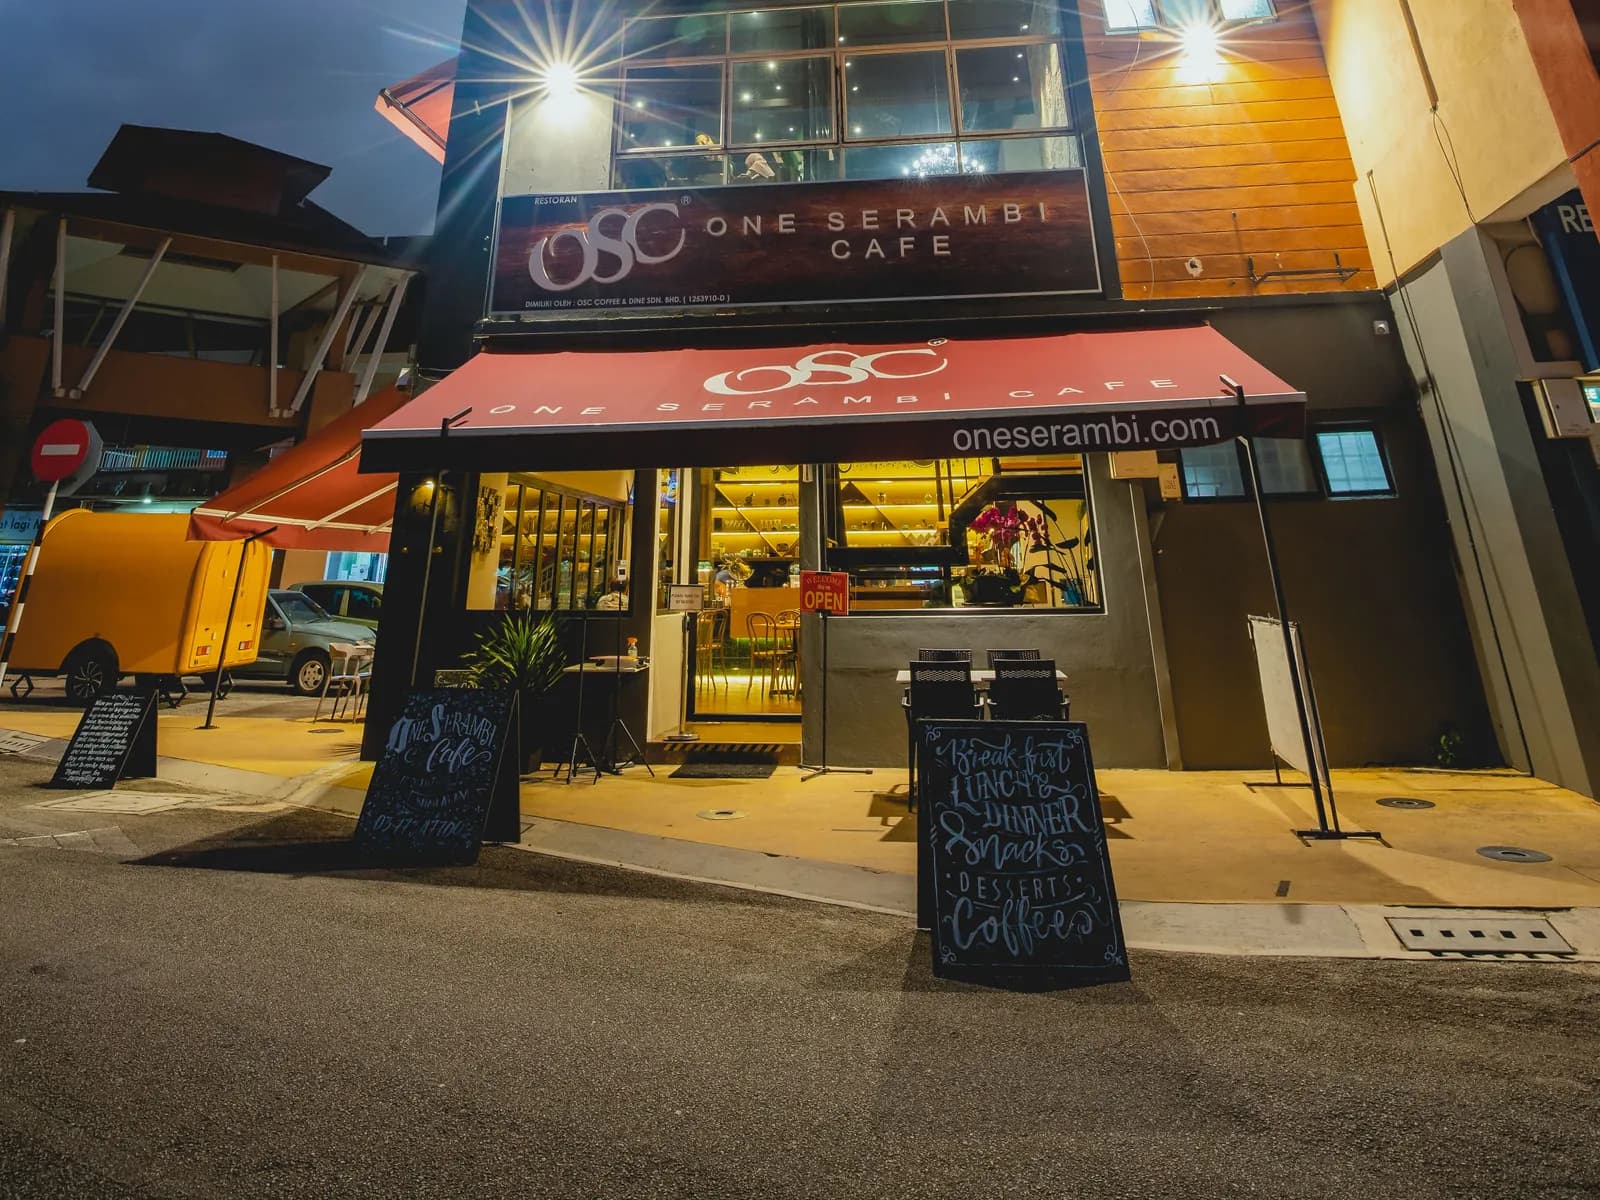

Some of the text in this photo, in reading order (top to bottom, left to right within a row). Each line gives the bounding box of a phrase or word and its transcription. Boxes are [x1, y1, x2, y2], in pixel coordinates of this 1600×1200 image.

[534, 195, 578, 206] RESTORAN
[705, 202, 1048, 239] ONE SERAMBI
[528, 202, 687, 292] OSC
[831, 234, 952, 260] CAFE
[577, 298, 592, 306] OSC
[593, 297, 621, 306] COFFEE
[628, 296, 646, 305] DINE
[703, 348, 949, 395] OSC
[488, 377, 1180, 417] ONE SERAMBI CAFE
[952, 413, 1221, 451] oneserambi.com
[10, 517, 31, 532] lagi
[804, 590, 844, 611] OPEN
[950, 769, 1034, 814] LUNCH
[982, 794, 1094, 837] DINNER
[940, 810, 1086, 871] Snacks
[959, 870, 1073, 901] DESSERTS
